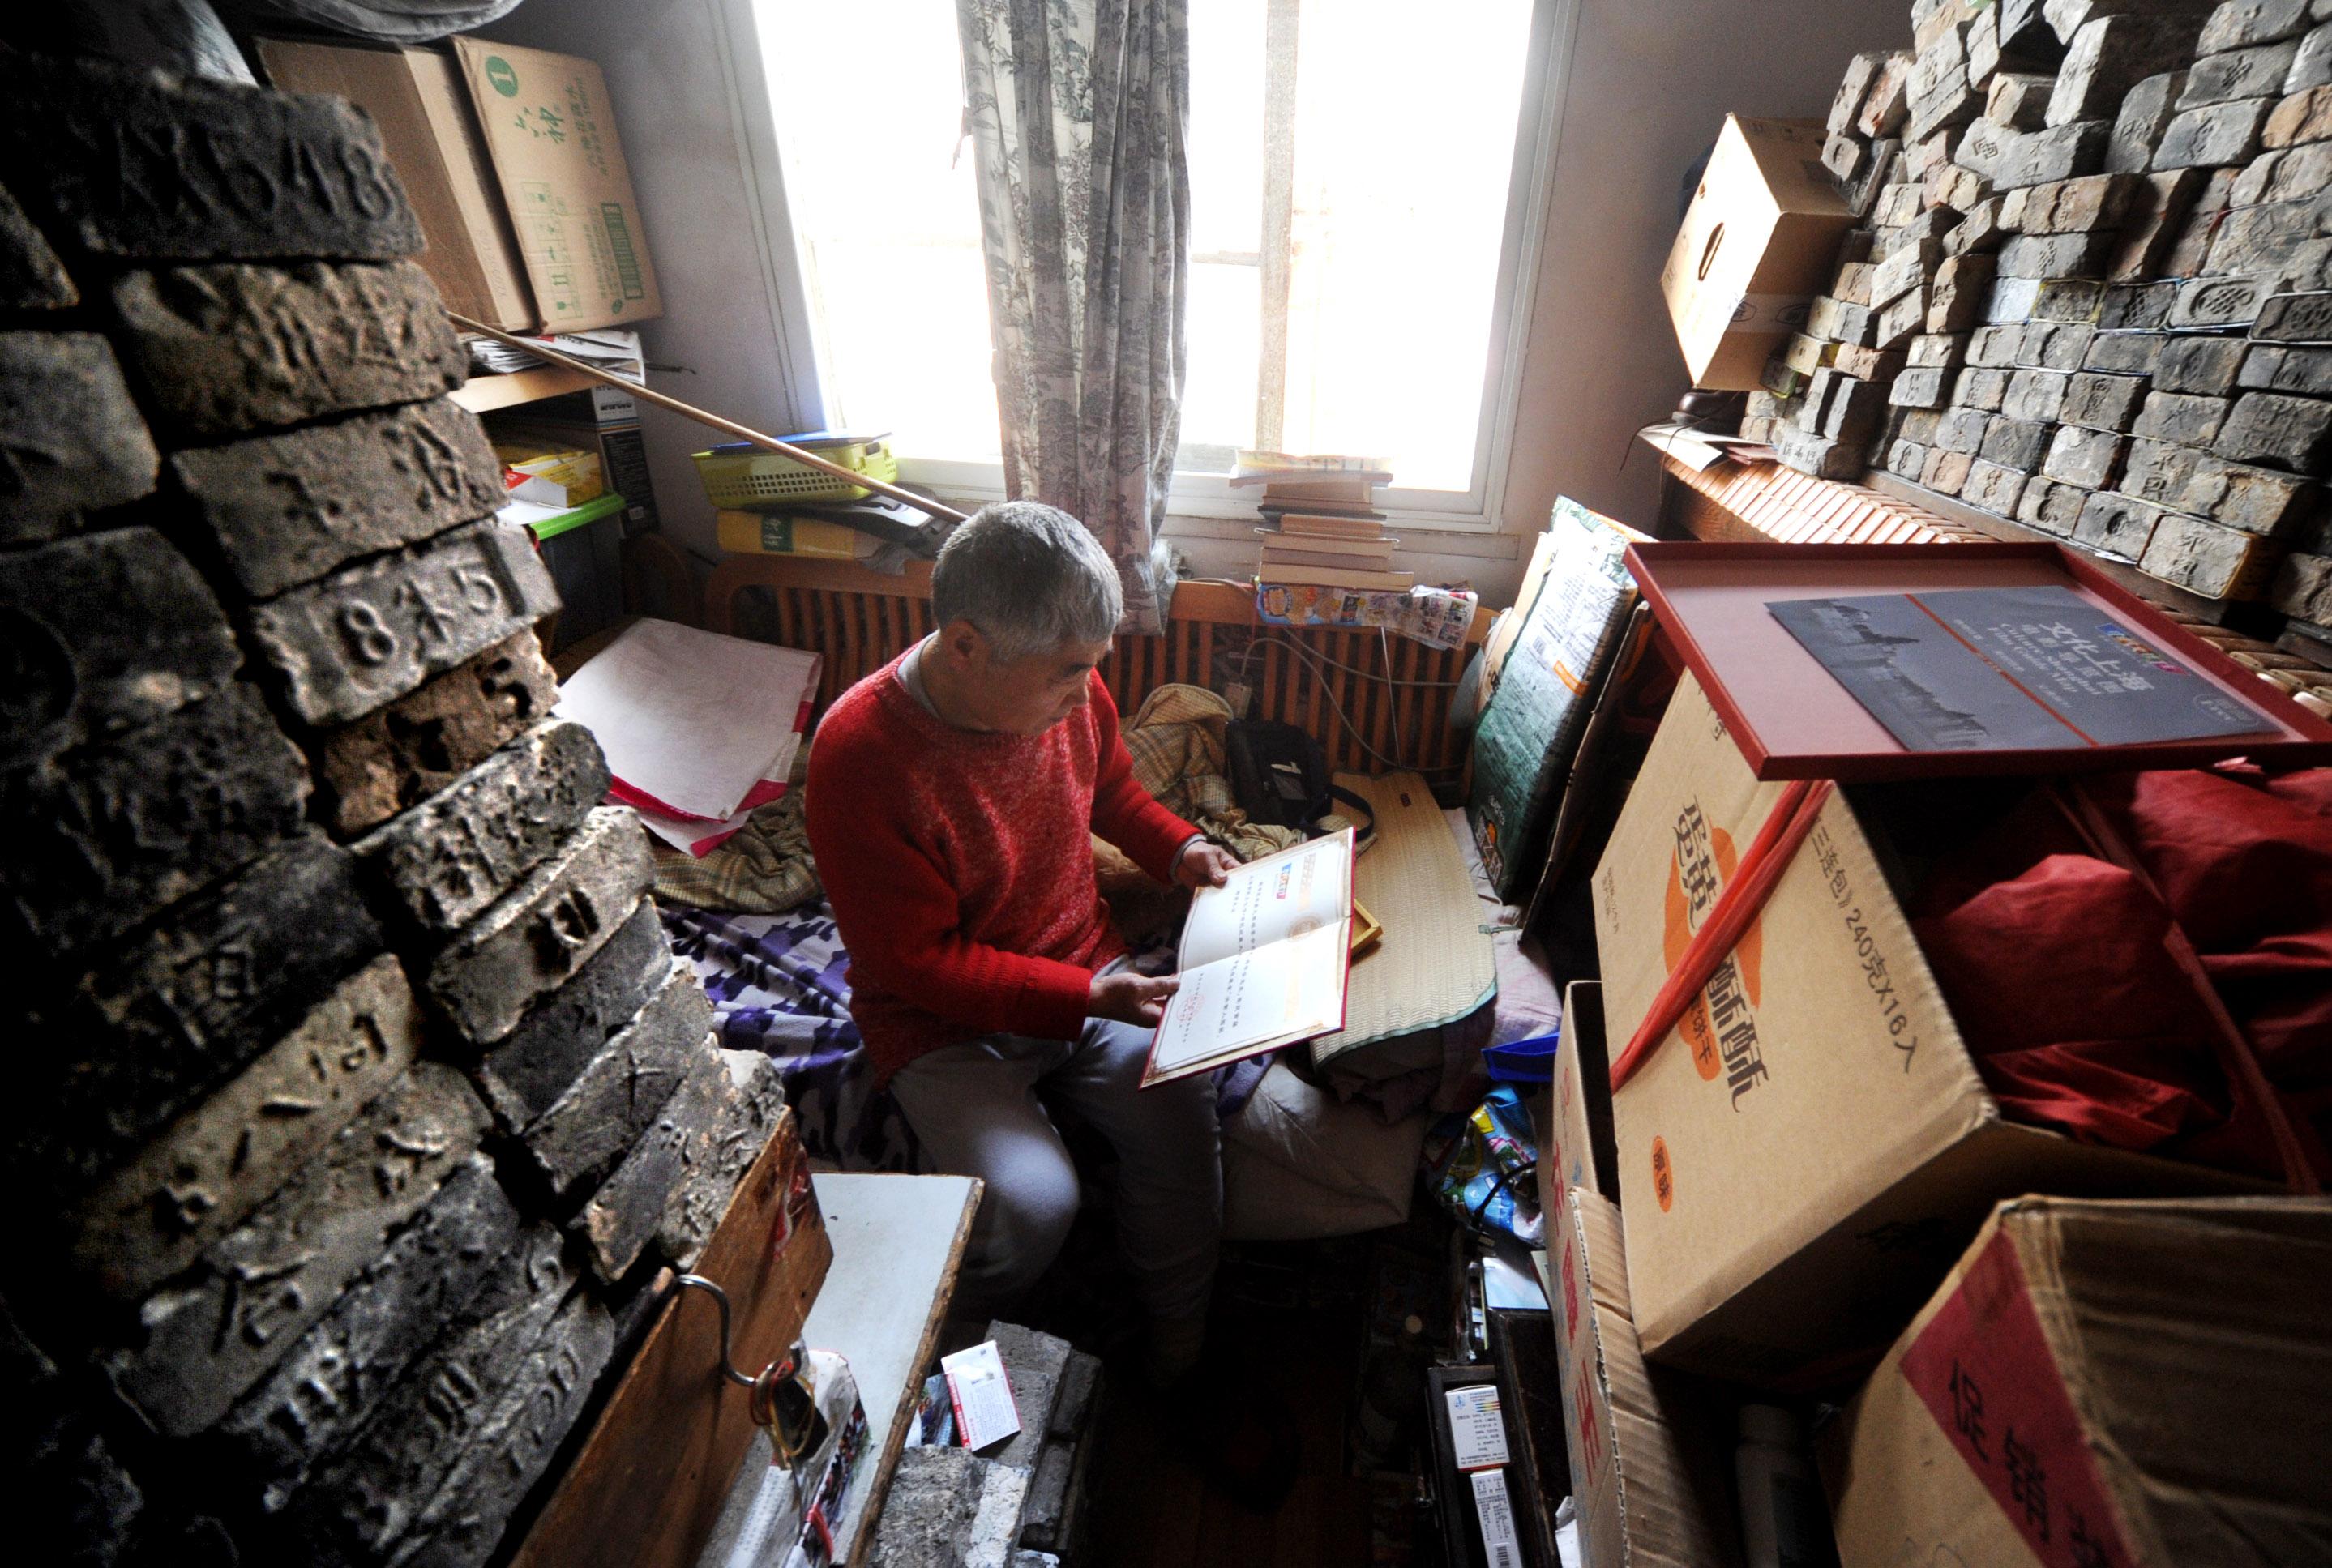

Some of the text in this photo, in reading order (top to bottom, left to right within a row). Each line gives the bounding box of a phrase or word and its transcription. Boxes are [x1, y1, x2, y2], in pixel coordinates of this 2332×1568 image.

[2039, 622, 2155, 691] 文化上海
[1811, 814, 1918, 1074] 三连包》240克X16入
